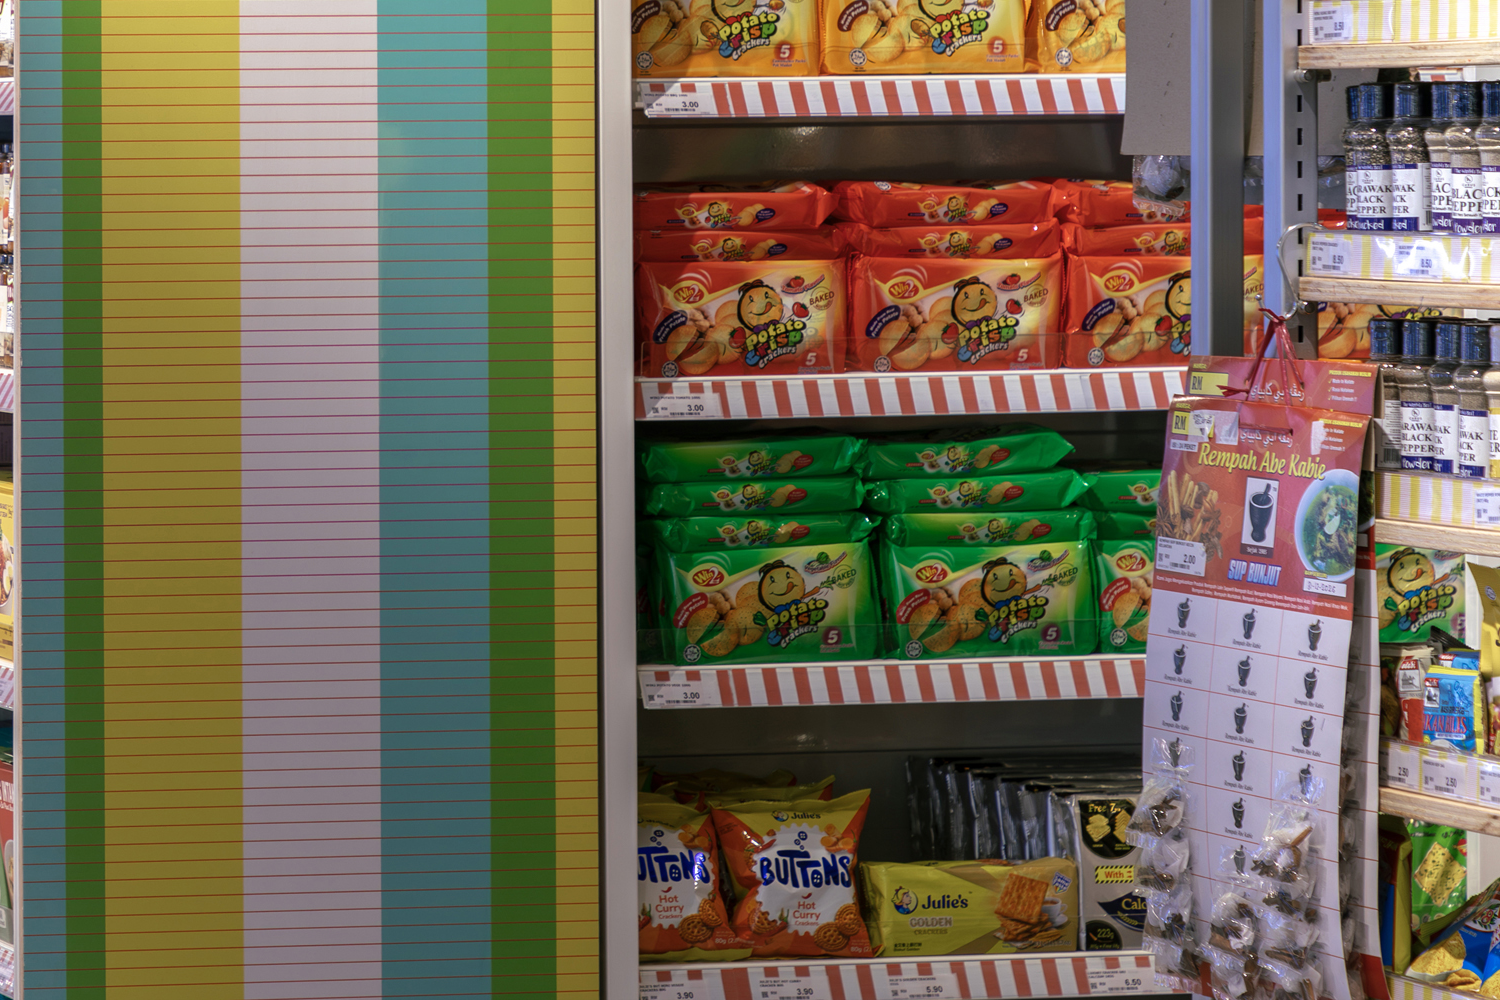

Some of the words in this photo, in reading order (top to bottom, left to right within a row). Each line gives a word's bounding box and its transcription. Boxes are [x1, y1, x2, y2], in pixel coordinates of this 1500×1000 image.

[1059, 5, 1076, 18] Potato
[780, 45, 790, 58] 5
[992, 40, 1003, 54] 5
[809, 291, 834, 306] BAKED
[1023, 288, 1049, 304] BAKED
[1097, 301, 1115, 316] Potato
[669, 315, 687, 329] Potato
[881, 310, 899, 324] Potato
[805, 352, 817, 365] 5
[1018, 349, 1028, 362] 5
[1191, 375, 1203, 390] RM
[688, 404, 704, 412] 3.00
[1174, 414, 1187, 431] RM
[1402, 434, 1432, 442] BLACK
[1198, 443, 1257, 472] Rempah
[1257, 452, 1285, 475] Abe
[1288, 453, 1326, 480] Kabie
[1183, 554, 1196, 564] 2.00
[832, 568, 856, 583] BAKED
[1053, 567, 1078, 580] BAKED
[1228, 559, 1249, 581] SUP
[1247, 562, 1282, 587] BUNJUT
[827, 630, 838, 644] 5
[1046, 626, 1058, 640] 5
[1088, 804, 1106, 812] Free
[791, 812, 821, 820] Julie's
[760, 850, 852, 888] BUTTONS
[1104, 870, 1124, 879] With
[659, 894, 678, 904] Hot
[798, 900, 816, 910] Hot
[922, 894, 968, 910] Julie's
[656, 904, 684, 915] Curry
[793, 910, 821, 921] Curry
[910, 917, 952, 928] GOLDEN
[1125, 978, 1142, 986] 6.50
[677, 992, 694, 1000] 3.90
[796, 988, 814, 996] 3.90
